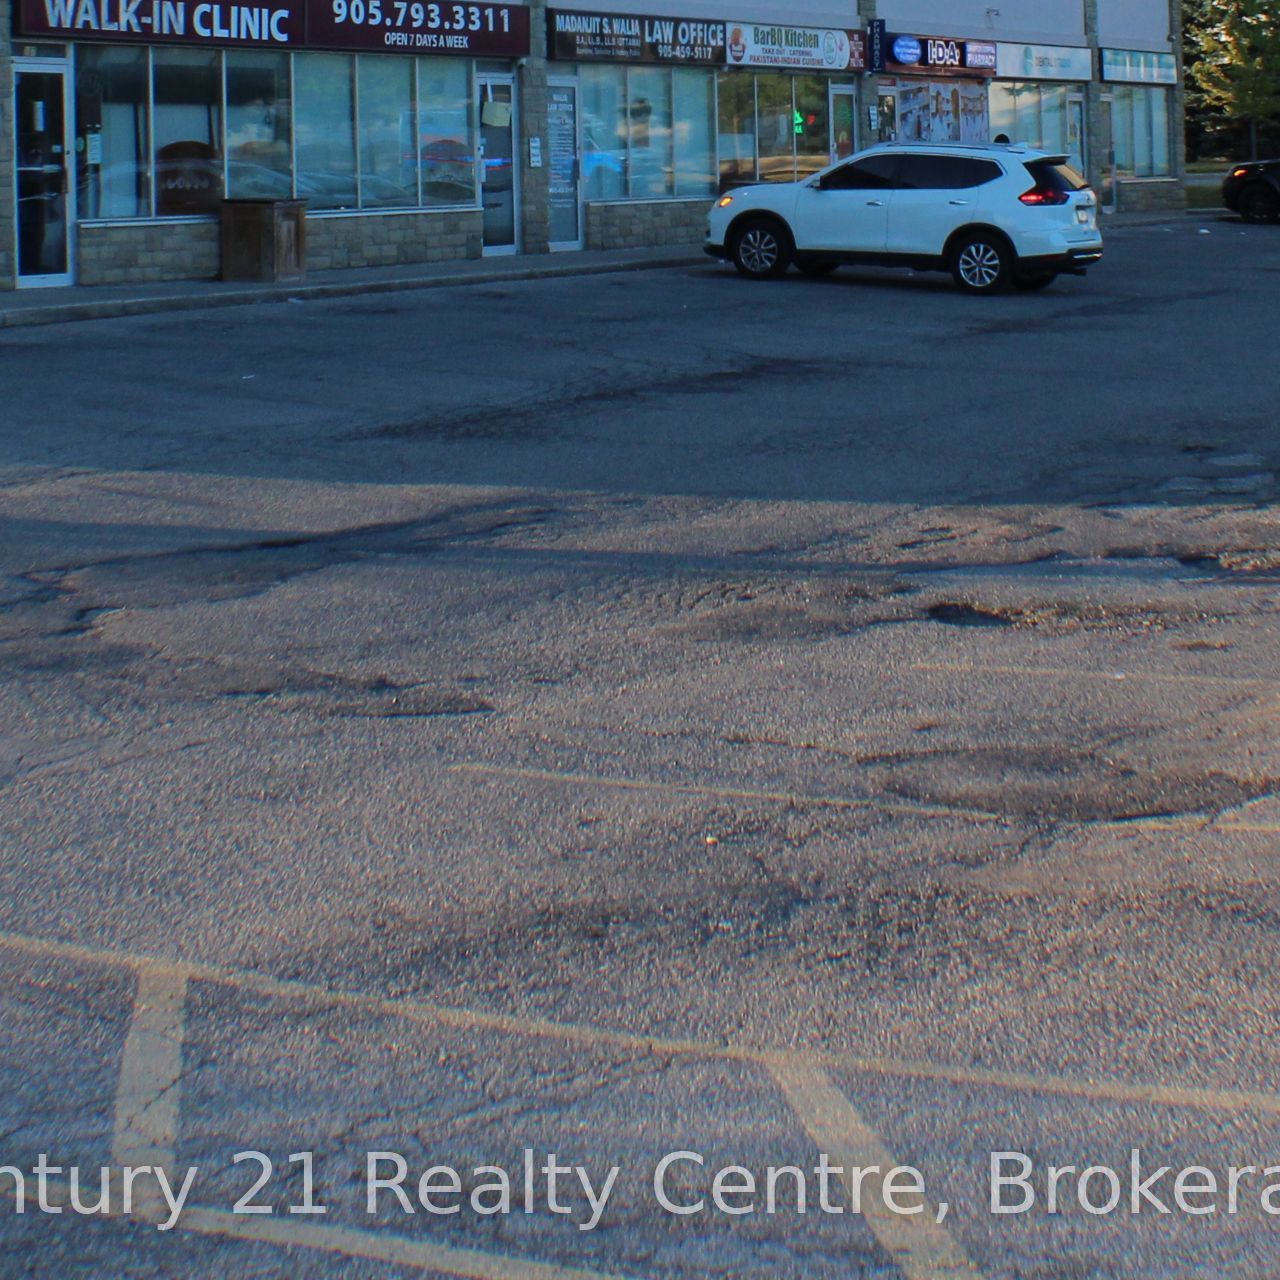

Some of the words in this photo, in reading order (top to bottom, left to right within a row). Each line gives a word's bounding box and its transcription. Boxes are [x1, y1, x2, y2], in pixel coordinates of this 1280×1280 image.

[193, 3, 289, 42] CLINIC
[556, 15, 601, 34] MADANJIT
[613, 18, 640, 35] WALIA
[644, 20, 674, 43] LAW
[678, 22, 724, 46] OFFICE
[384, 32, 408, 46] OPEN
[409, 34, 415, 45] 7
[416, 34, 438, 47] DAYS
[438, 35, 446, 48] A
[446, 36, 469, 48] WEEK
[753, 26, 782, 47] BarBQ
[784, 28, 818, 48] Kitchen
